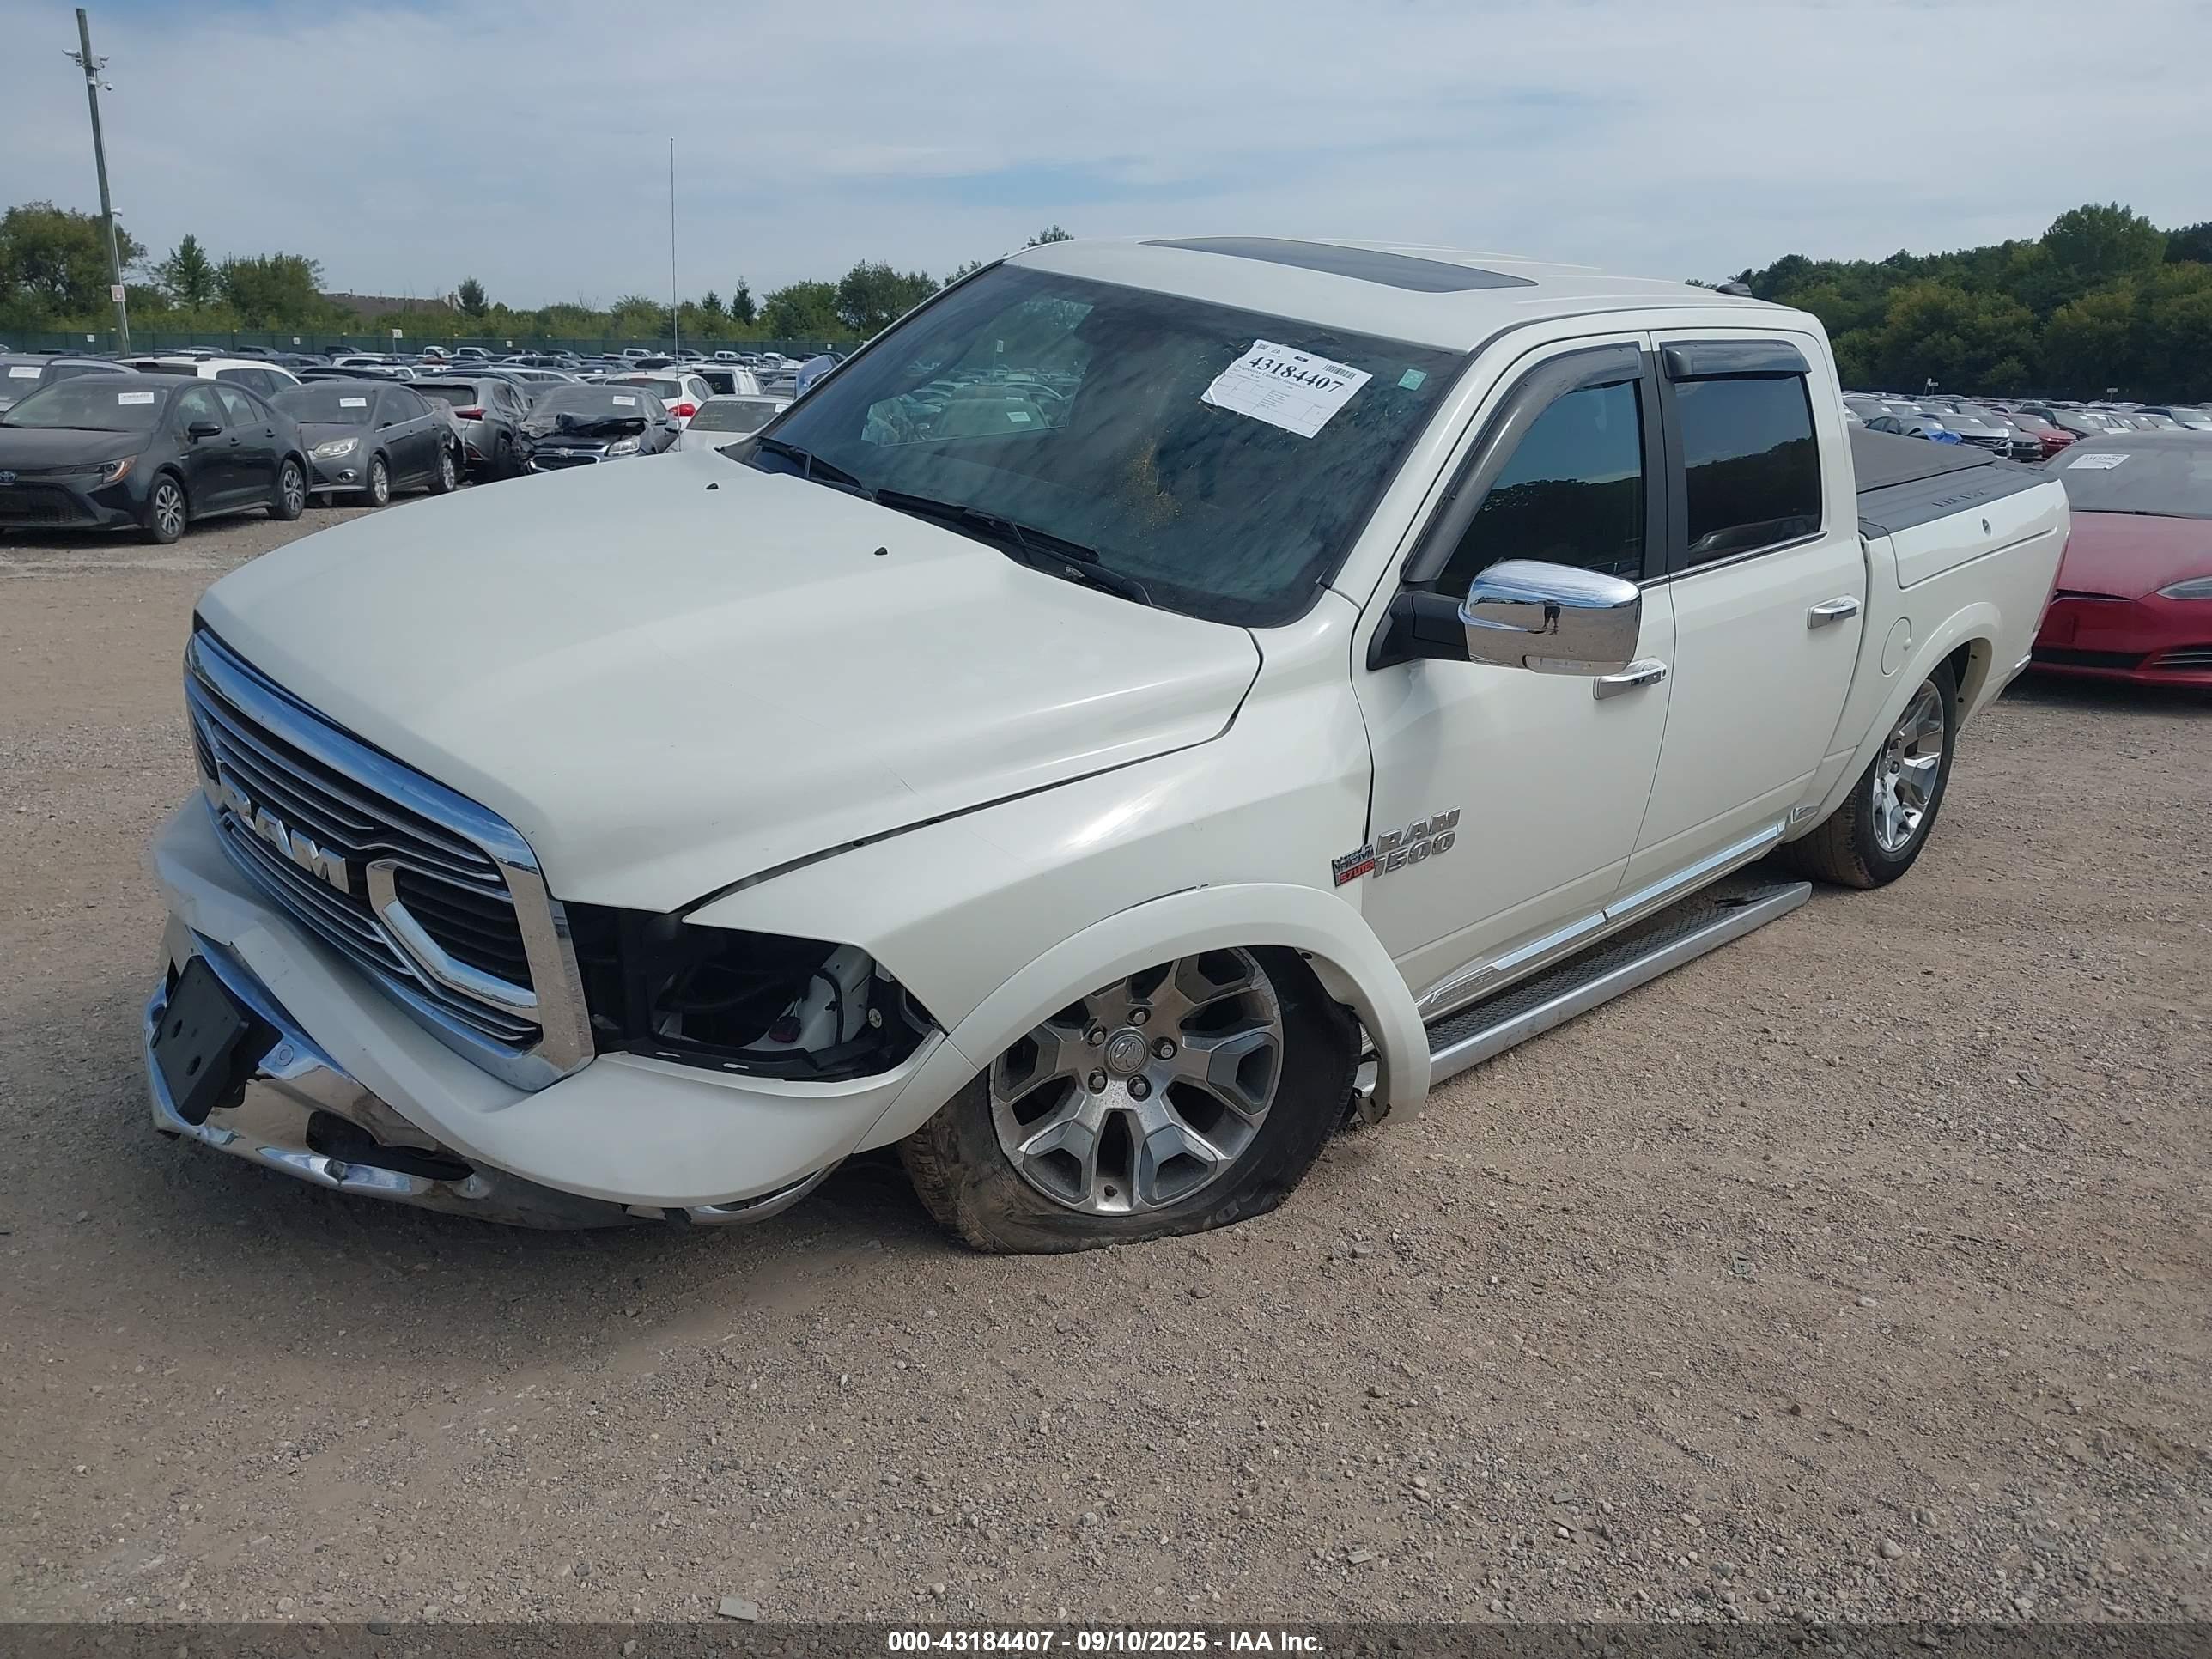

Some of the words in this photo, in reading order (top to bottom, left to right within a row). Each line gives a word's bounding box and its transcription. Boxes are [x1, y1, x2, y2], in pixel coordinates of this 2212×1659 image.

[1249, 357, 1344, 392] 43184407
[220, 771, 350, 894] RAM
[1376, 805, 1461, 854] RAM
[1373, 830, 1456, 878] 1500
